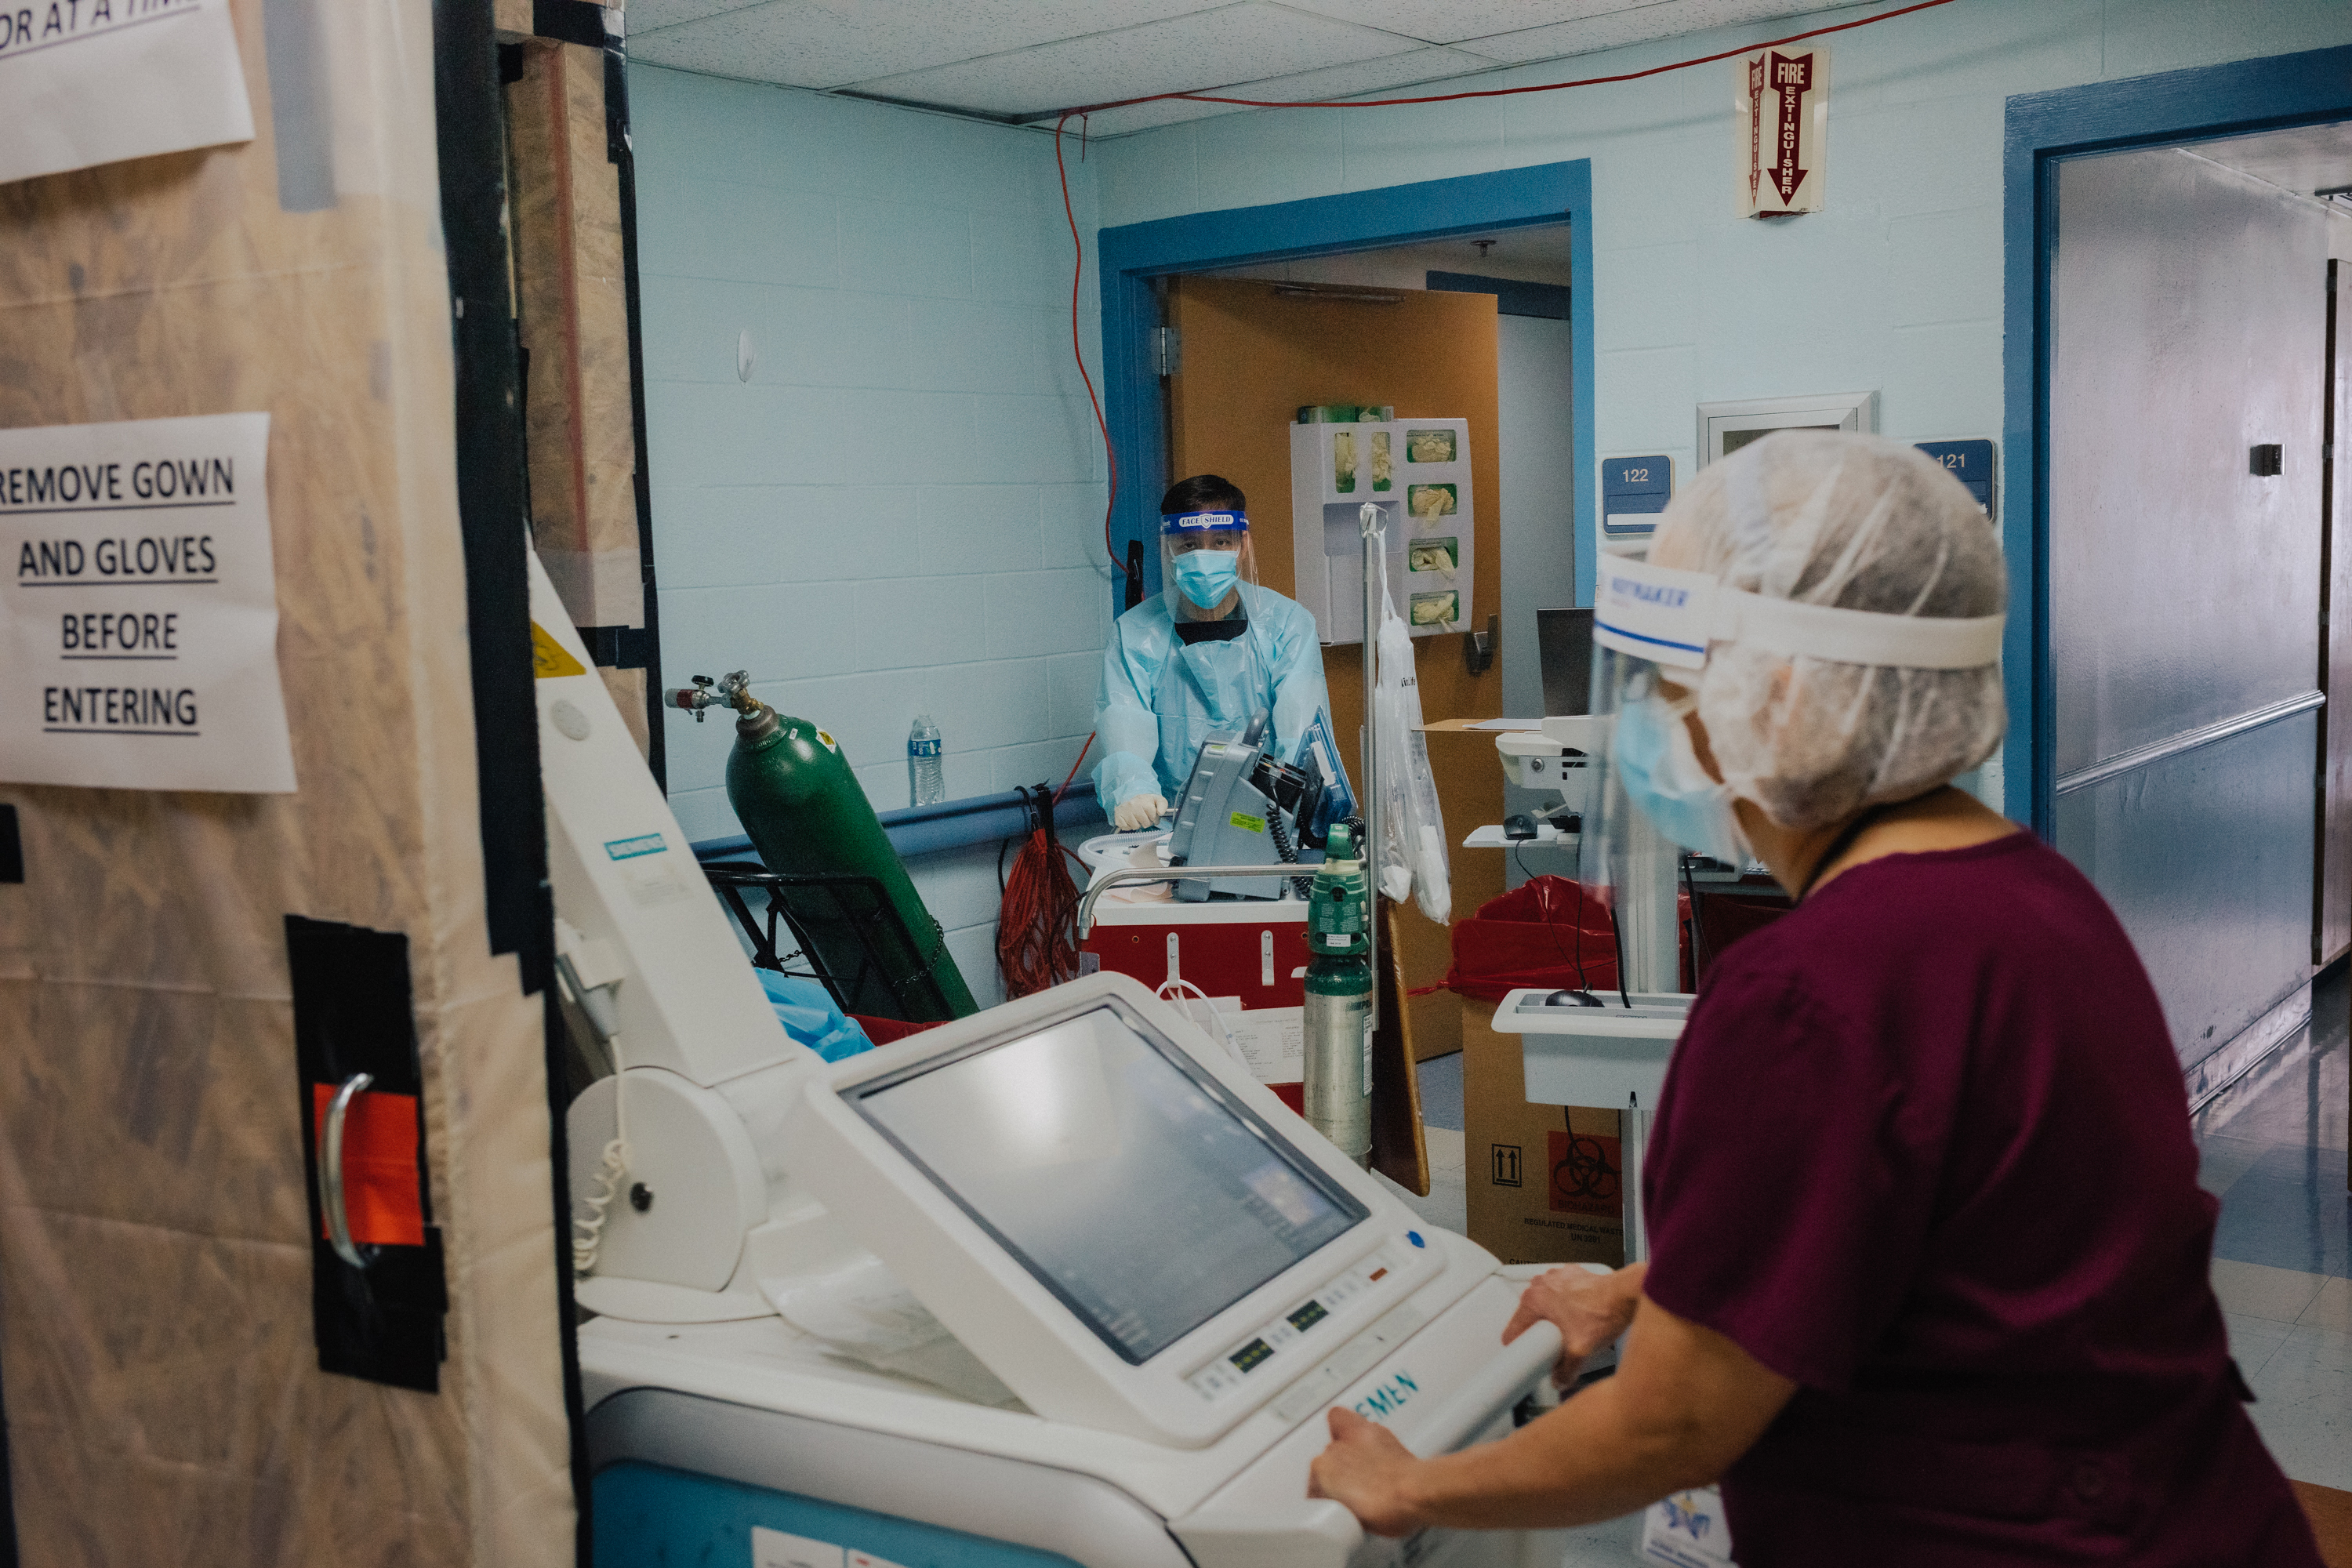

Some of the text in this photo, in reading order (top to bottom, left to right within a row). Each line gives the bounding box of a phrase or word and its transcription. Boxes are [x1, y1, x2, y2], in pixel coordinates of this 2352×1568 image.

[1751, 65, 1762, 90] FIRE
[1777, 62, 1805, 85] FIRE
[1781, 85, 1795, 195] EXTINGUISHER
[1936, 453, 1965, 469] 121
[132, 458, 234, 499] GOWN
[1622, 468, 1649, 483] 122
[18, 535, 216, 578] AND GLOVES
[60, 612, 178, 651] BEFORE
[44, 687, 198, 727] ENTERING
[1558, 1199, 1615, 1214] BIOHAZARD
[1524, 1218, 1624, 1236] REGULATED MEDICAL WASTE
[1570, 1232, 1582, 1242] UN
